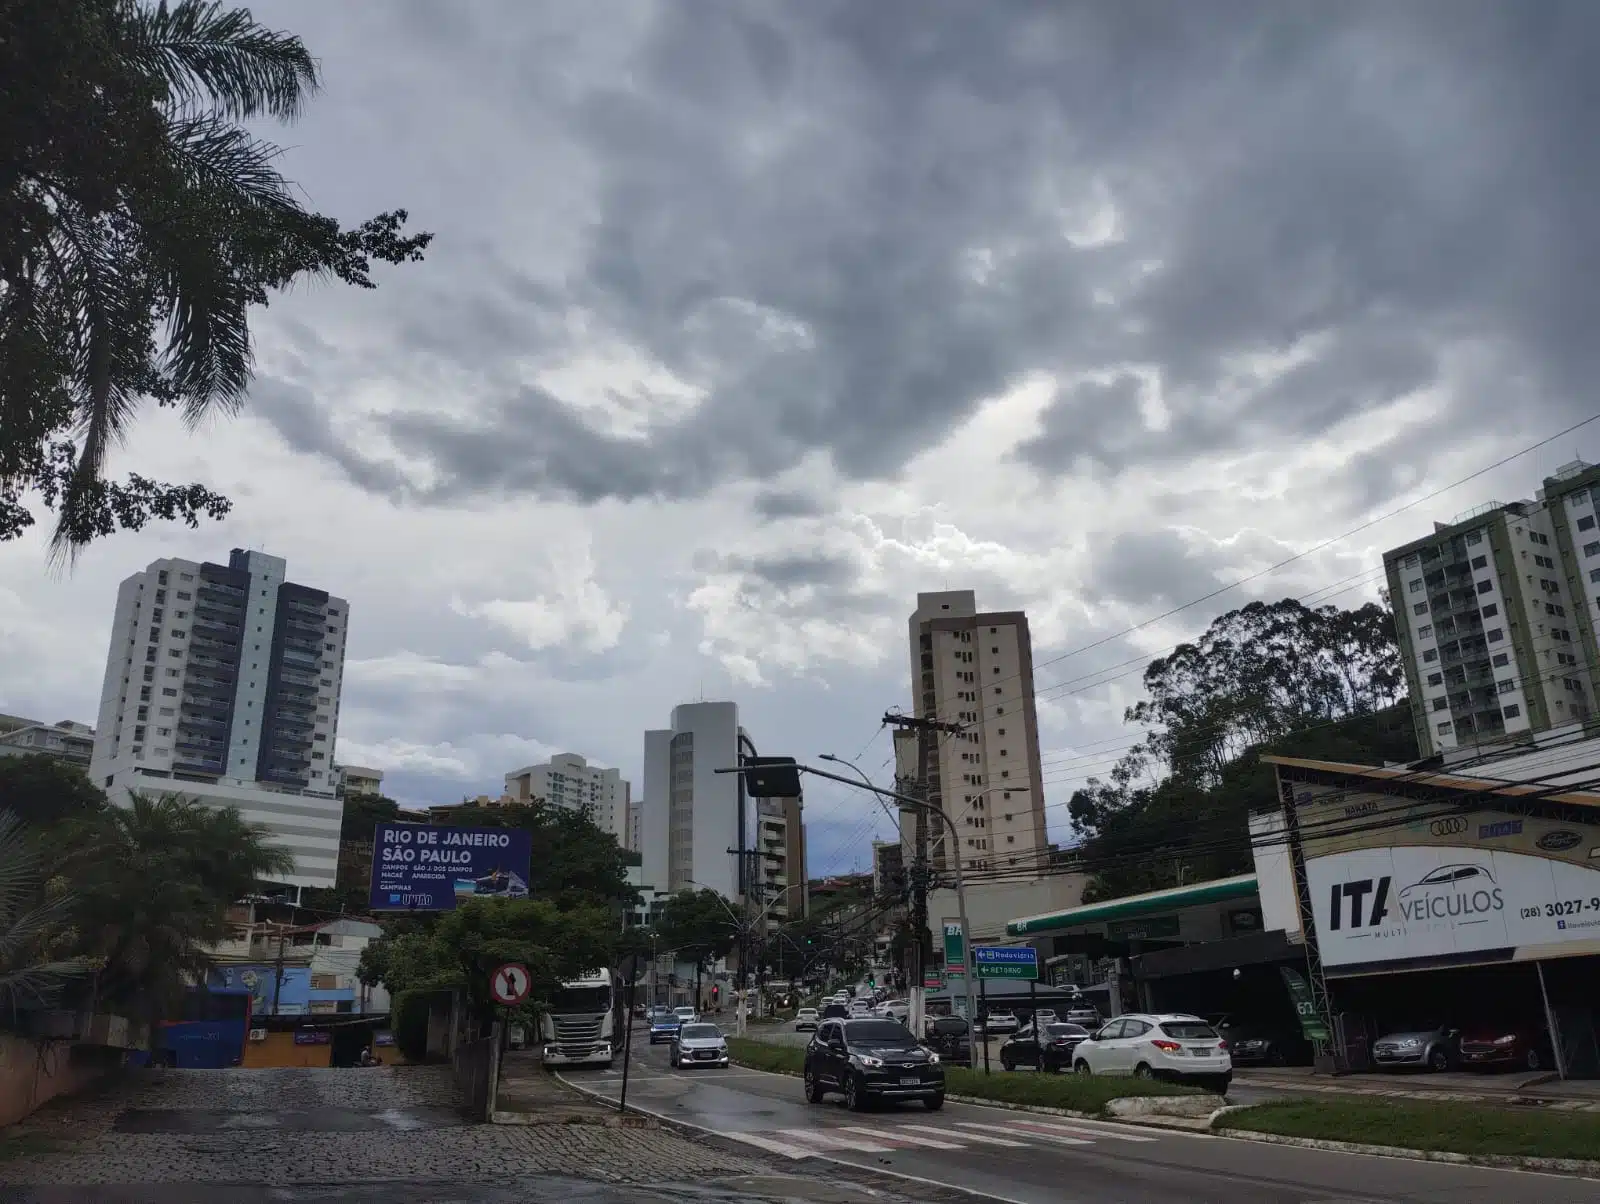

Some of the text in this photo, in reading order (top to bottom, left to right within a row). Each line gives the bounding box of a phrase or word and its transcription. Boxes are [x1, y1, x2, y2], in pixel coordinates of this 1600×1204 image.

[384, 829, 510, 847] RIO DE JANEIRO
[382, 845, 472, 864] SÃO PAULO
[412, 872, 446, 880] APARECIDA
[413, 863, 426, 871] SÃO
[1331, 876, 1392, 931] ITA
[1400, 888, 1504, 923] VEÍCULOS
[1520, 897, 1600, 920] (28) 3027-9
[1016, 920, 1028, 932] BR
[990, 966, 1022, 974] RETORNO
